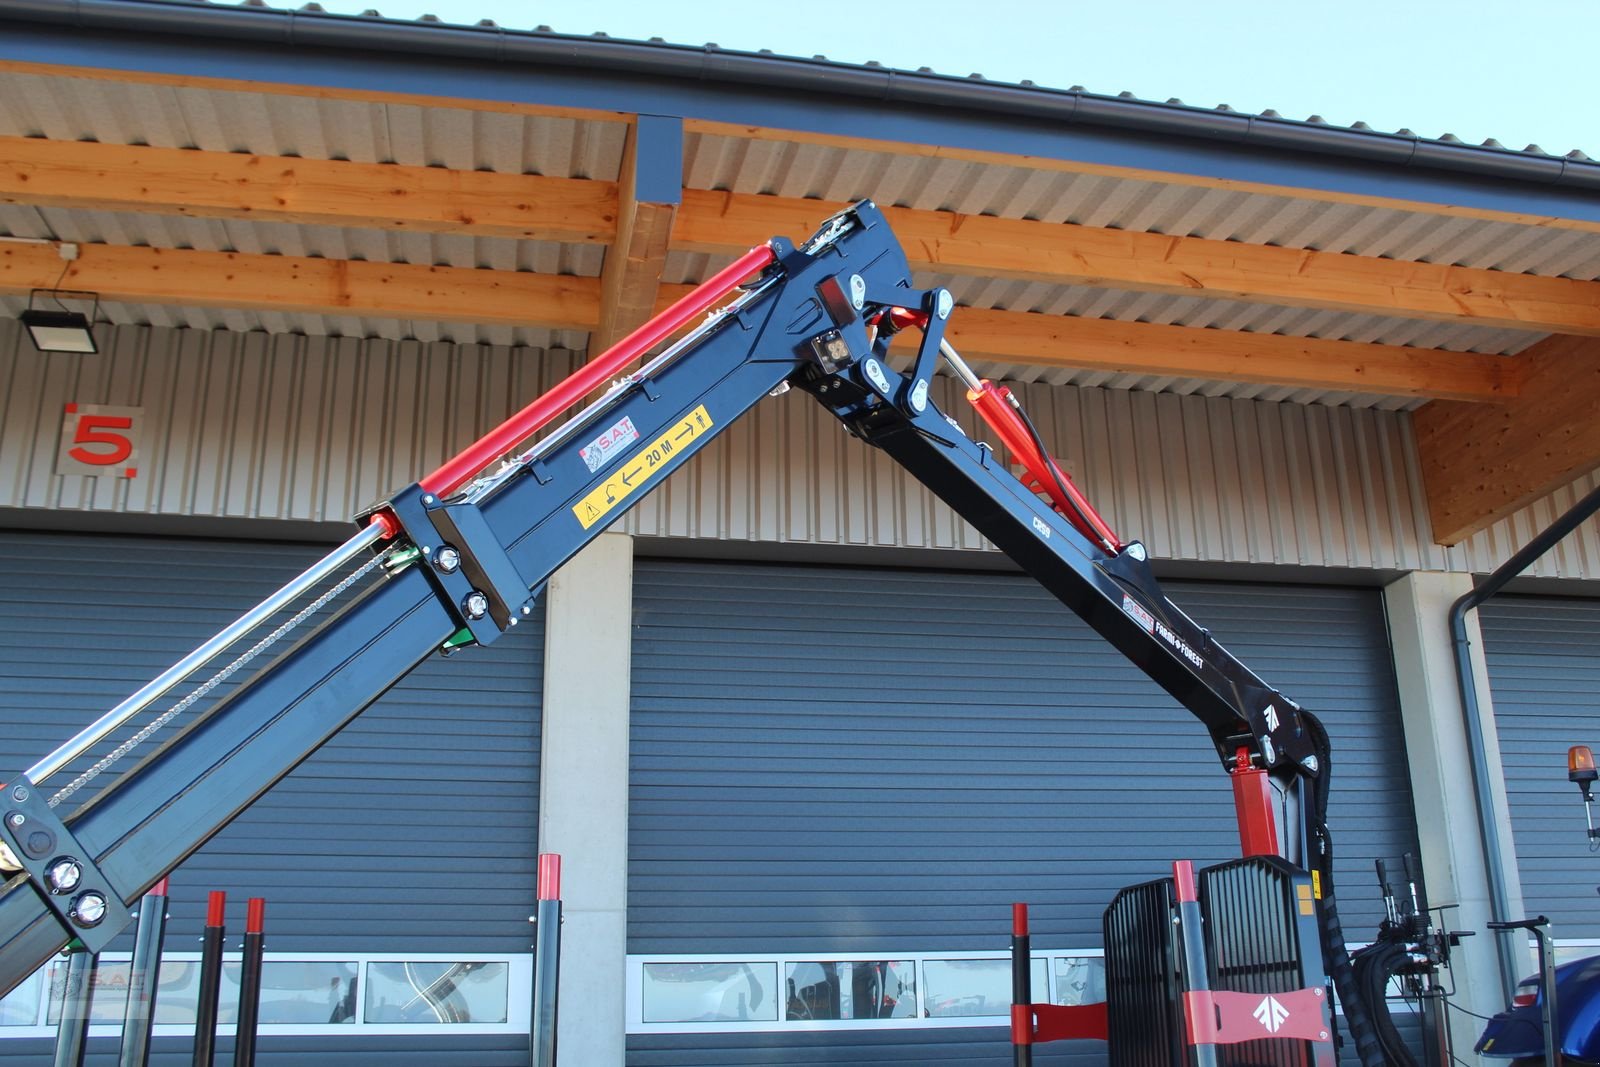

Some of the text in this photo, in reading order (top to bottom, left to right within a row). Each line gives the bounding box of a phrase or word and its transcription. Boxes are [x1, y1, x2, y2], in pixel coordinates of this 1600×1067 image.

[67, 415, 132, 466] 5
[599, 420, 632, 449] S.A.T.
[646, 440, 673, 467] 20 M
[1156, 621, 1175, 646] FARMI
[1181, 643, 1203, 669] FOREST
